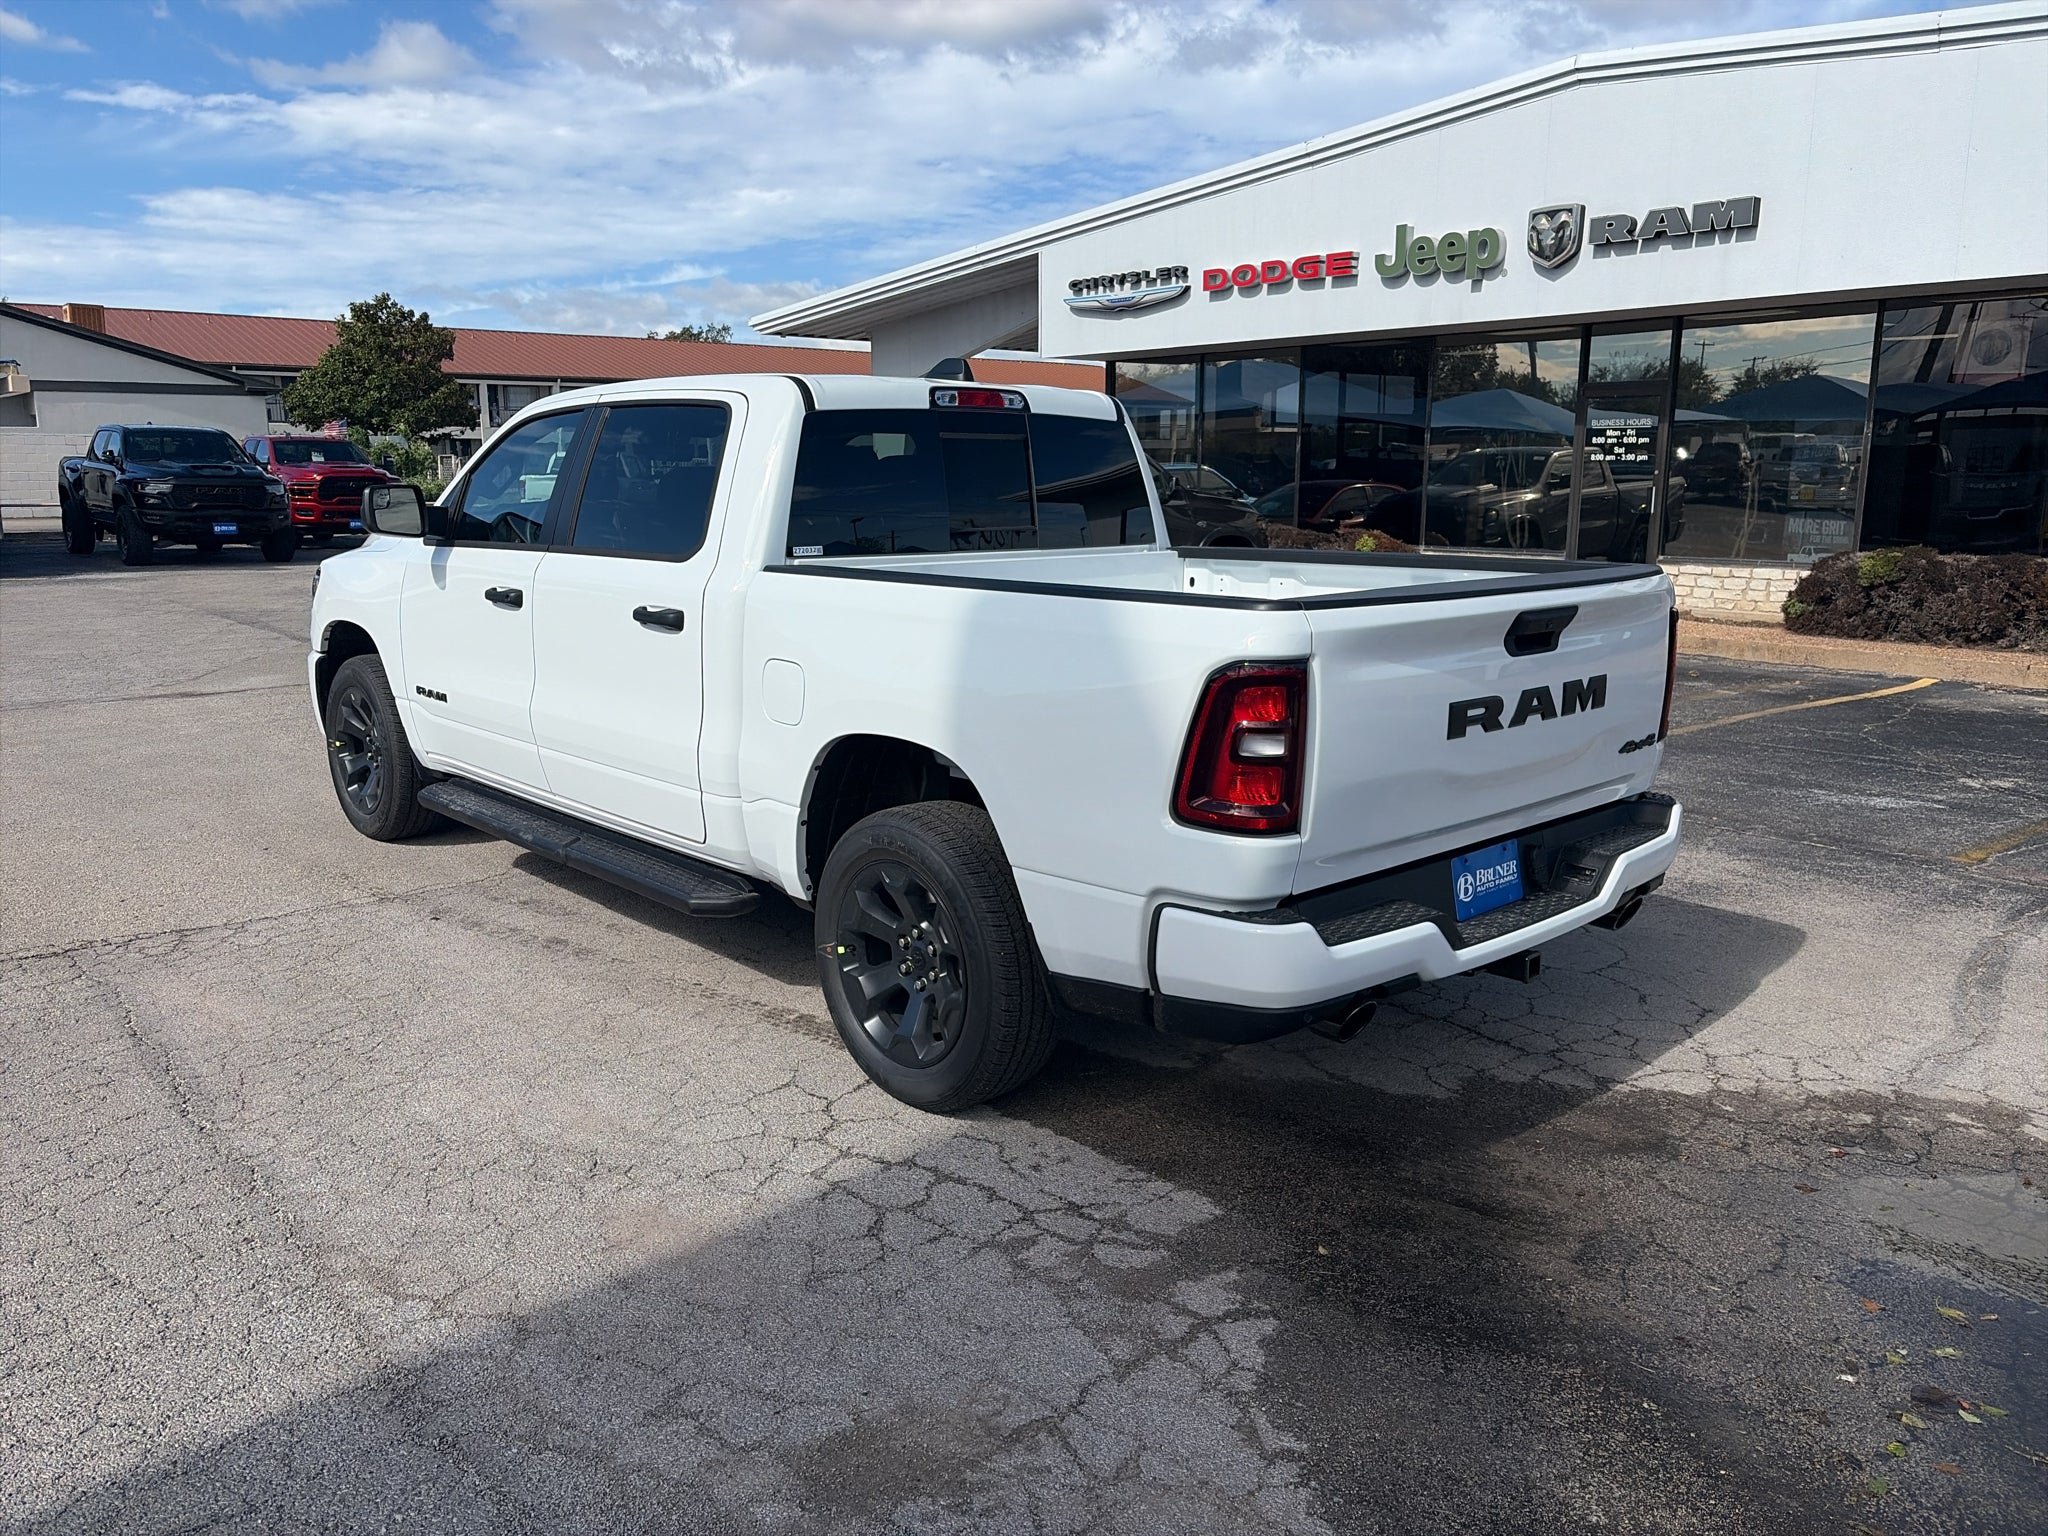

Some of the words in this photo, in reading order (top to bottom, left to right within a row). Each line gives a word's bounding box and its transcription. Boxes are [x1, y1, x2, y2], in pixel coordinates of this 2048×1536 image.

[1589, 195, 1761, 245] RAM
[1374, 223, 1503, 280] Jeep
[1068, 264, 1189, 293] CHRYSLER
[1203, 250, 1361, 292] DODGE
[1613, 446, 1625, 454] Sat
[1623, 436, 1637, 444] 6:00
[1637, 437, 1650, 445] pm
[1636, 454, 1649, 462] pm
[1788, 517, 1820, 534] MORE
[1822, 519, 1847, 535] GRIT
[415, 685, 448, 703] RAM
[1446, 673, 1608, 741] RAM
[1475, 859, 1517, 886] BRUNER
[1476, 881, 1495, 893] AUTO
[1495, 872, 1518, 887] FAMILY
